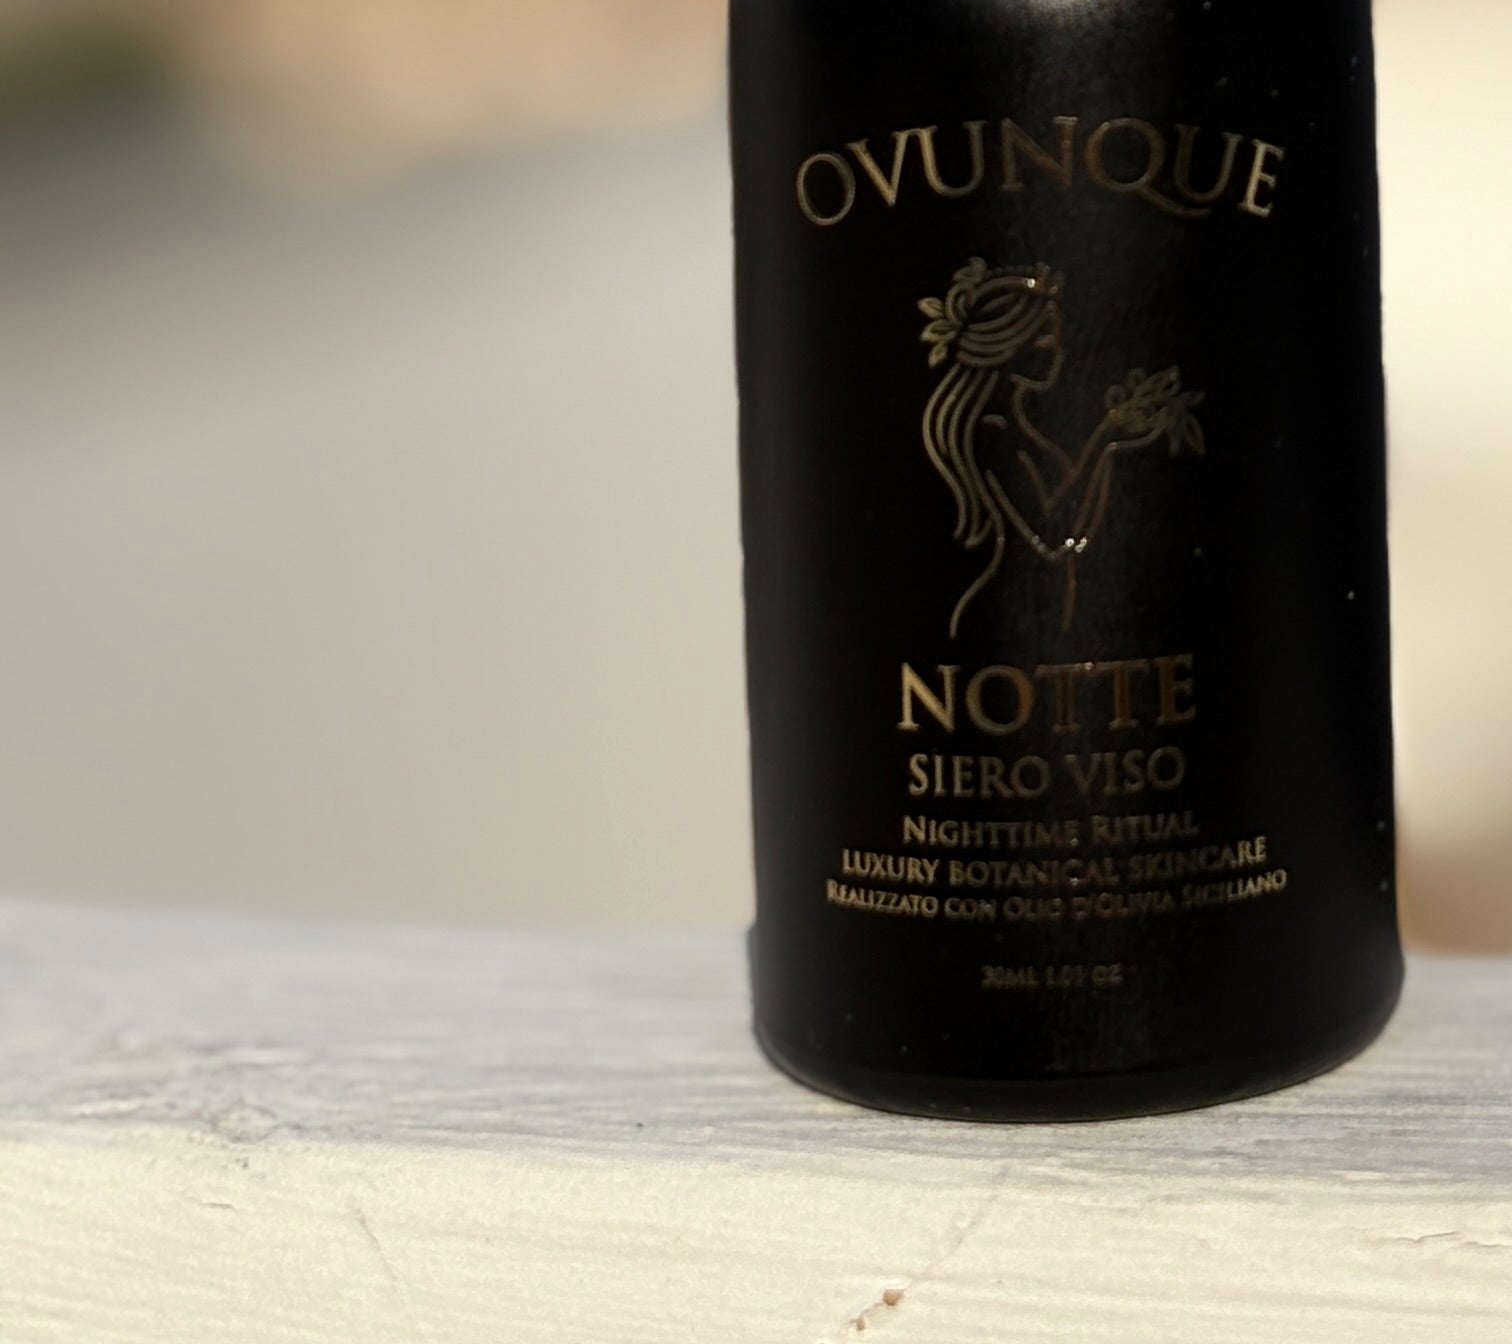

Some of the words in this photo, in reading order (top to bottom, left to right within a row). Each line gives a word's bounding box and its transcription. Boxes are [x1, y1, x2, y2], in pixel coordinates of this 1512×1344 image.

[797, 116, 1286, 226] OVUNQUE
[897, 653, 1197, 736] NOTTE
[908, 752, 1050, 799] SIERO
[1063, 746, 1186, 797] VISO
[902, 814, 1081, 849] NIGHTTIME
[840, 848, 941, 886] LUXURY
[948, 858, 1121, 890] BOTANICAL
[1128, 834, 1269, 884] SKINCARE
